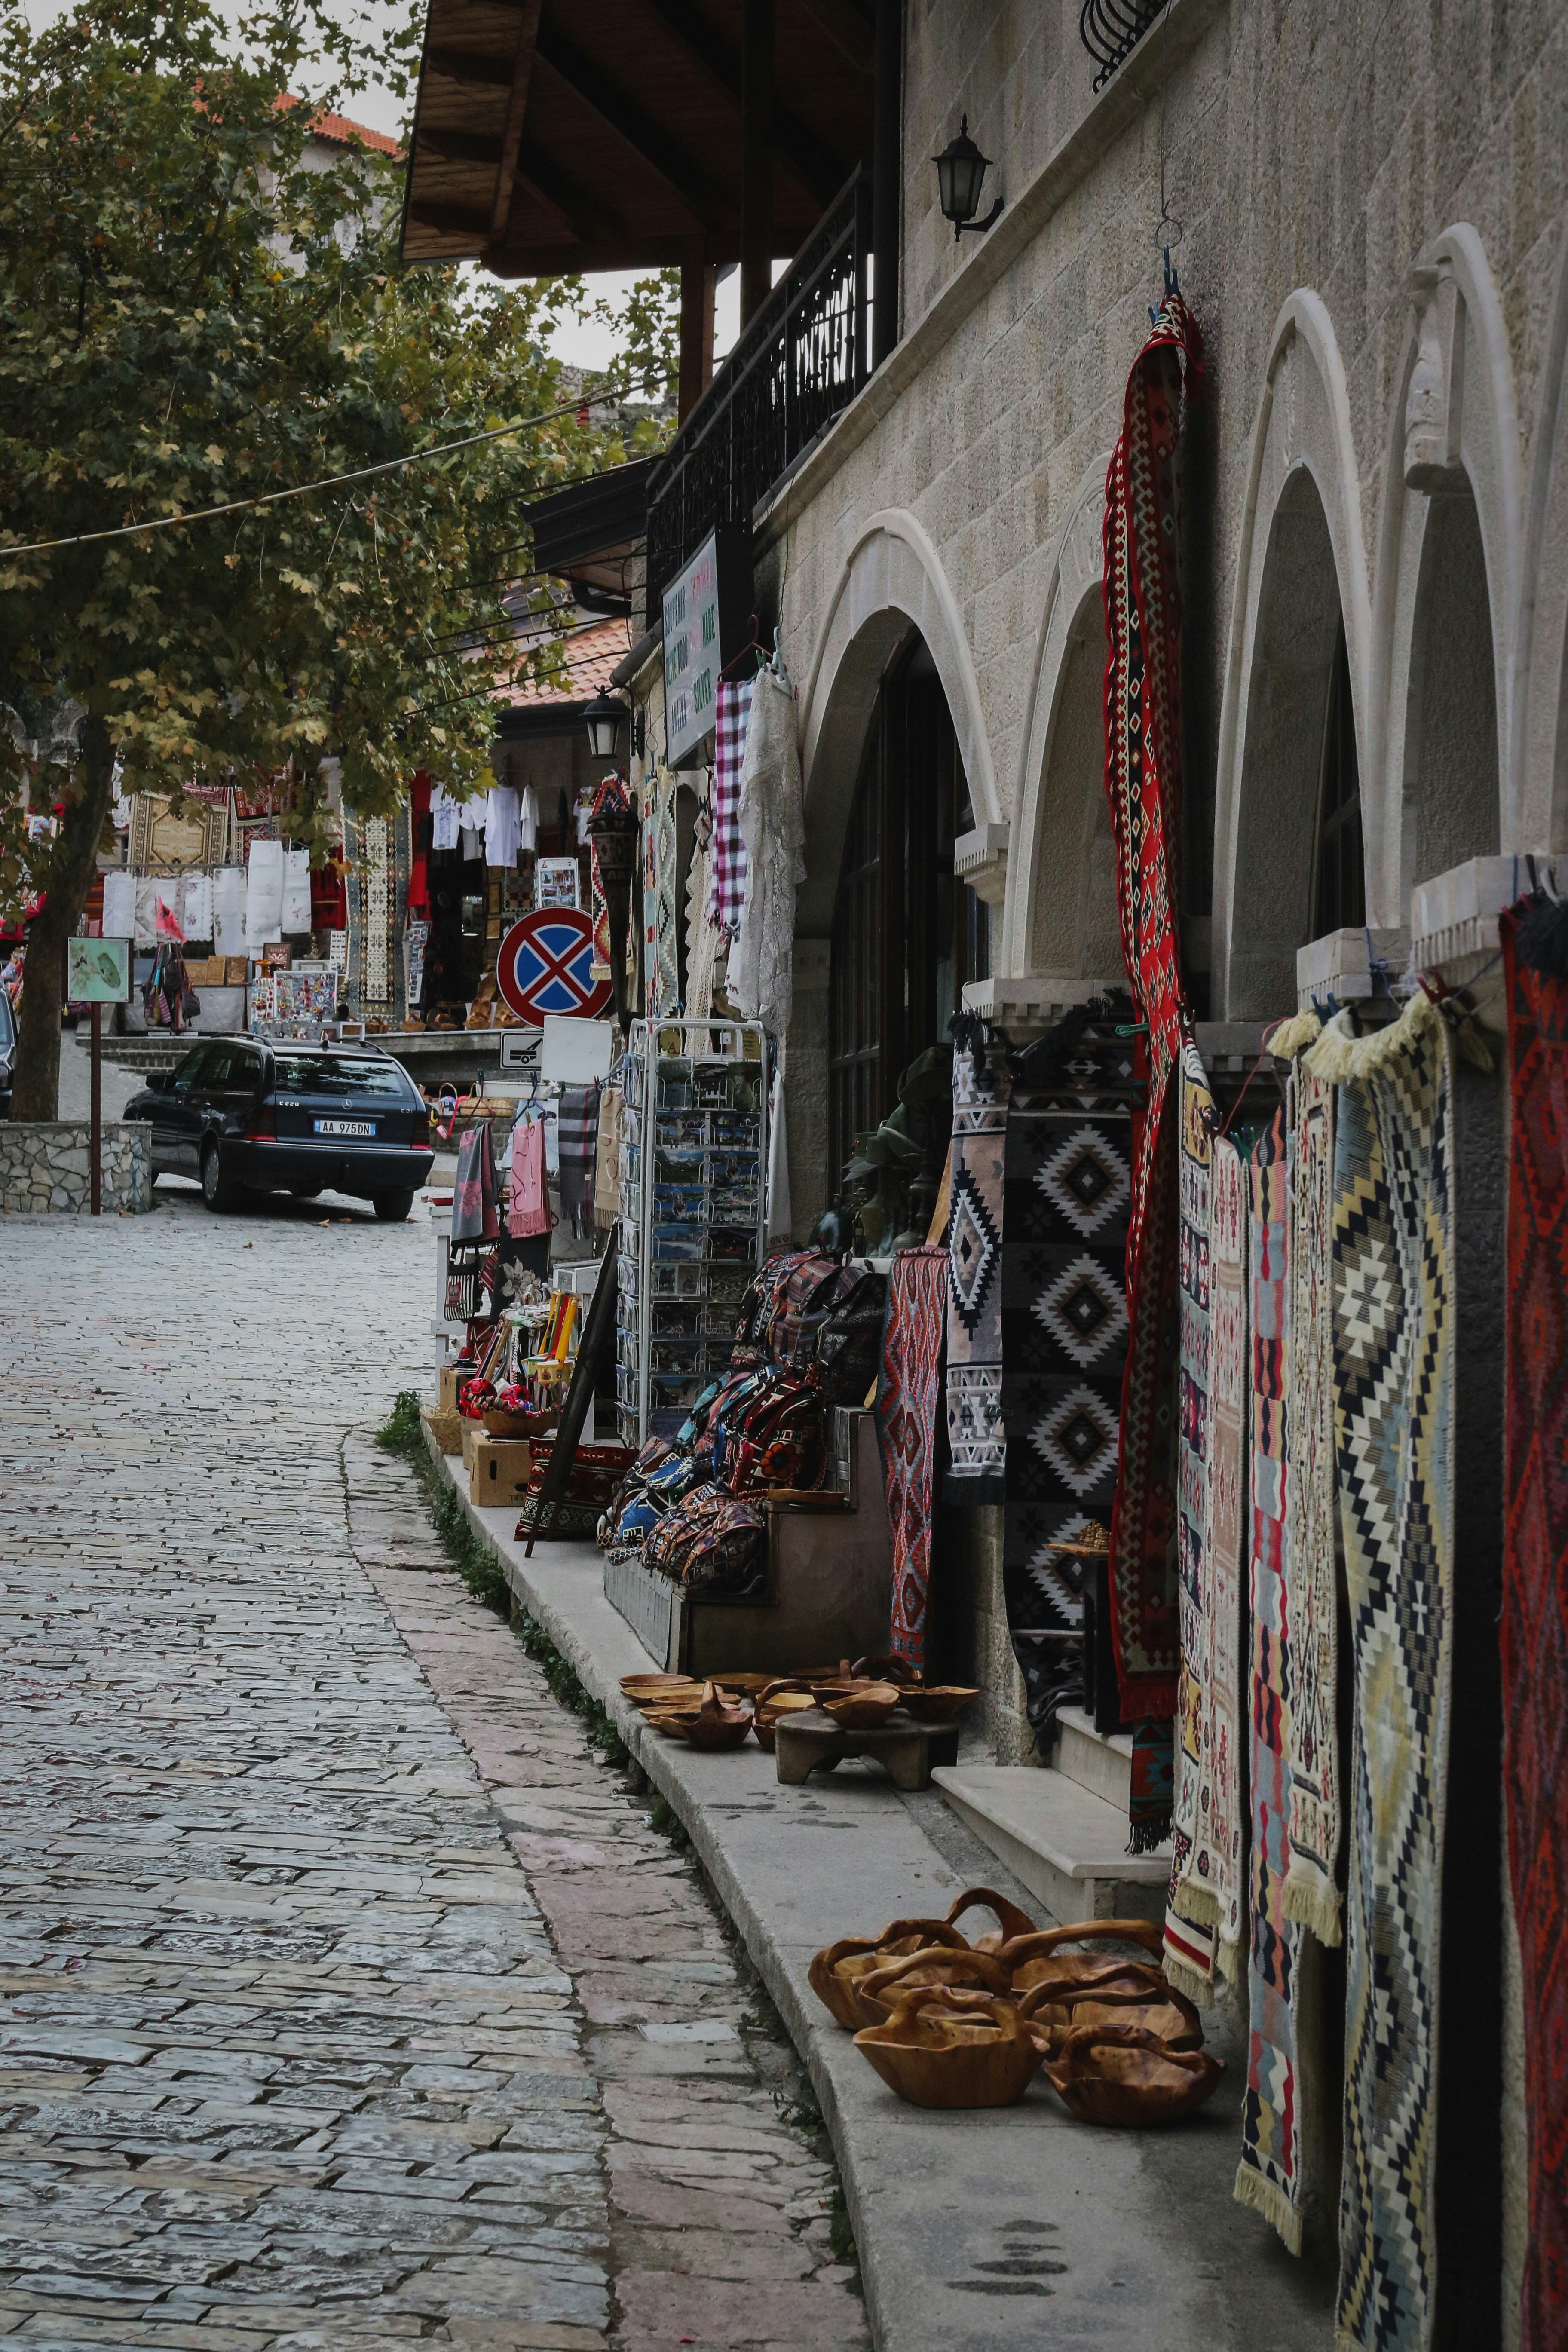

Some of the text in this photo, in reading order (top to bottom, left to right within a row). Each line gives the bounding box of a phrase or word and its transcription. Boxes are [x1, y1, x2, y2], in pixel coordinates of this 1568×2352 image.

[665, 585, 685, 637] SOUVENIR
[702, 604, 715, 648] MADE
[694, 668, 712, 714] SILVER
[323, 1121, 334, 1133] AA
